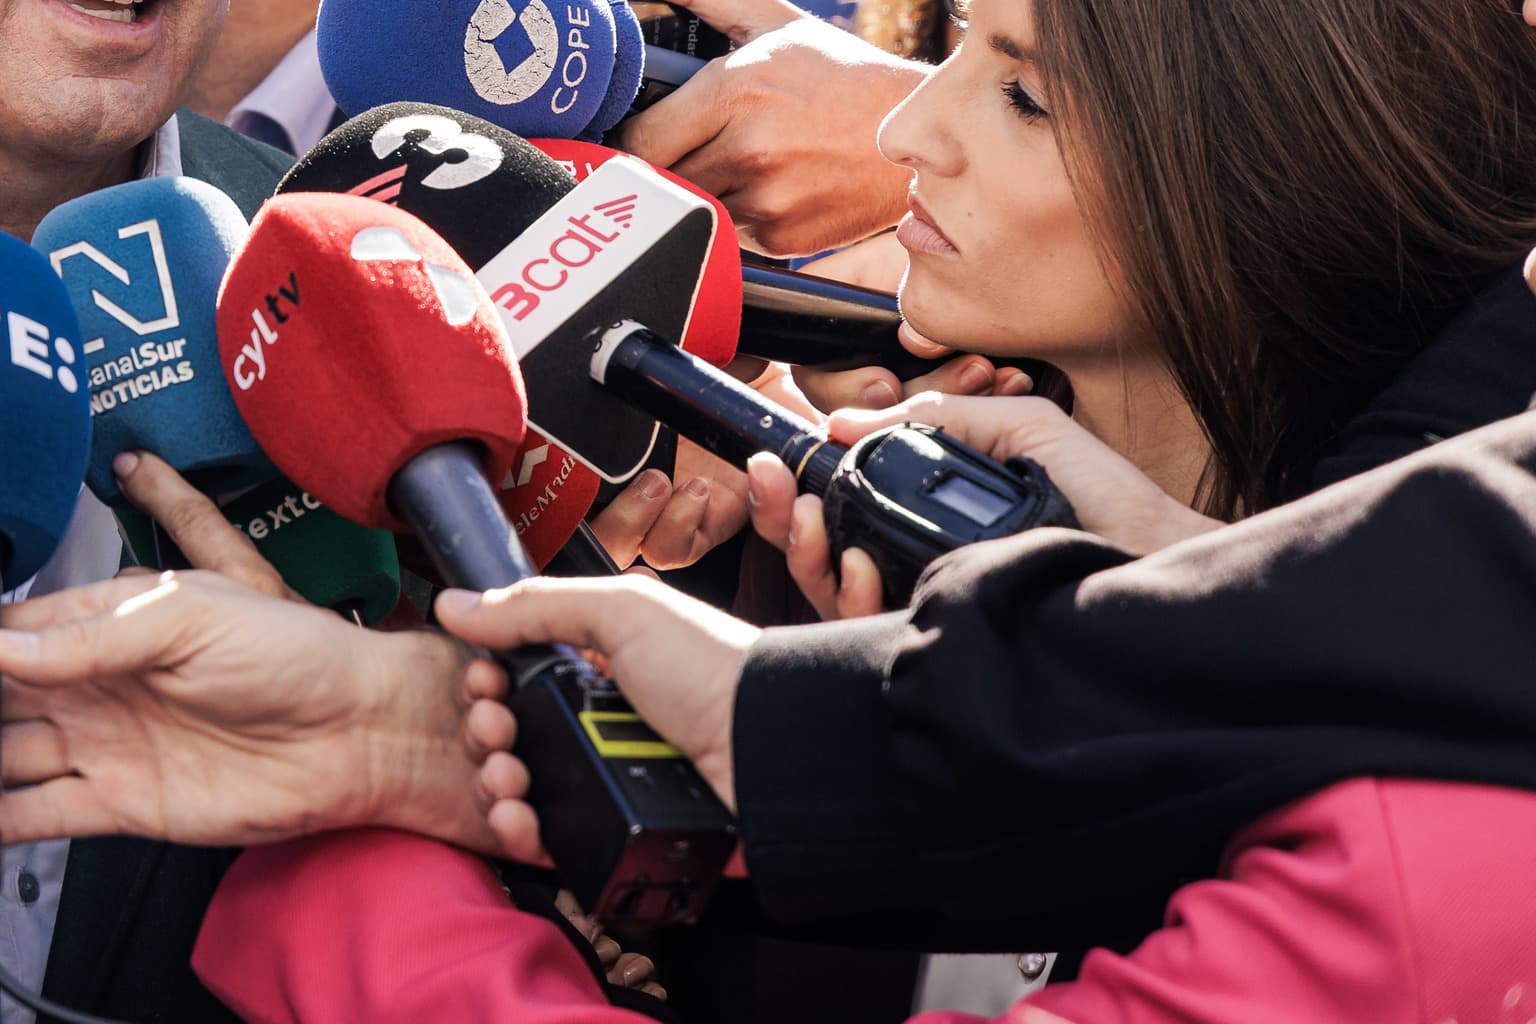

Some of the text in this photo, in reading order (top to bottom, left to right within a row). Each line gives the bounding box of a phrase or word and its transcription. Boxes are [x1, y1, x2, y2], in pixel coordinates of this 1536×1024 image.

[551, 5, 590, 114] COPE
[371, 114, 505, 190] 3
[489, 214, 621, 322] 3cat
[88, 337, 186, 388] analSur
[90, 360, 195, 416] NOTICIAS
[232, 491, 324, 539] ext
